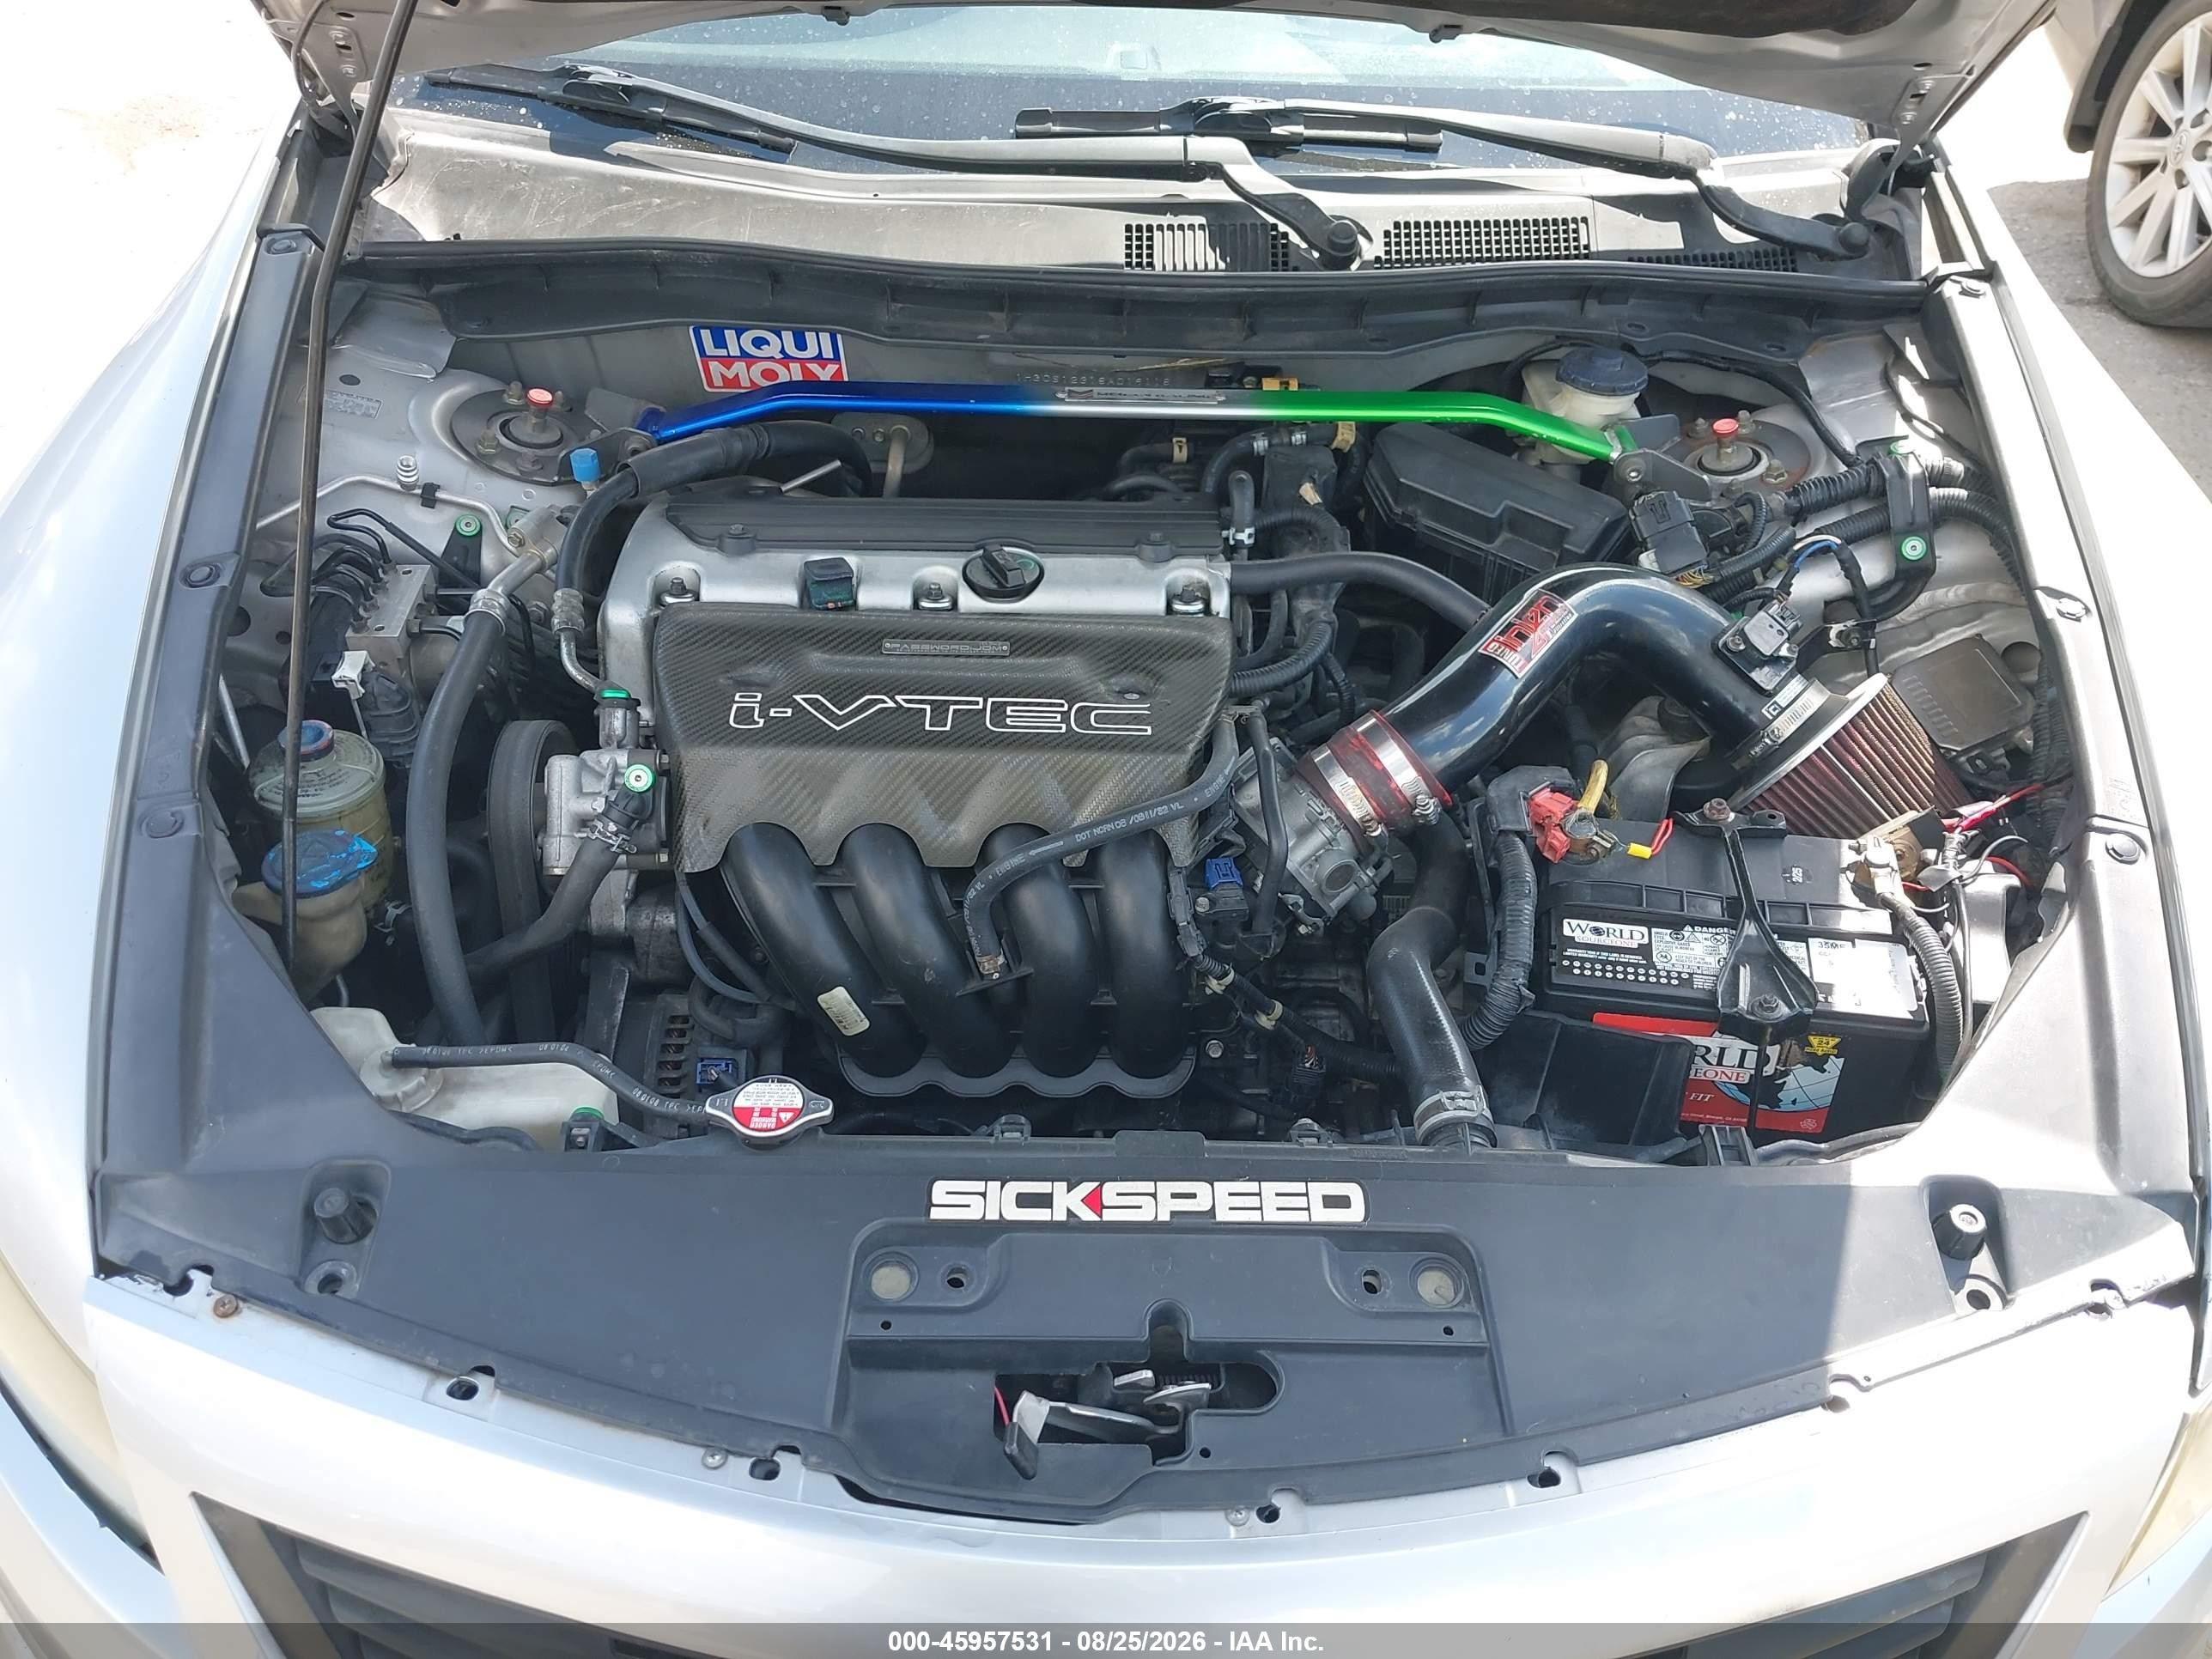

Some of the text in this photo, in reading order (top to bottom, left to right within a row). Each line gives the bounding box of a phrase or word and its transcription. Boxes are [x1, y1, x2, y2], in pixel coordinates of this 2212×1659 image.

[700, 329, 834, 359] LIQUI
[708, 361, 840, 387] MOLY
[728, 692, 1152, 736] i-VTEC
[1075, 830, 1091, 842] DOT
[1689, 1092, 1715, 1103] FIT
[929, 1180, 1367, 1222] SICKSPEED
